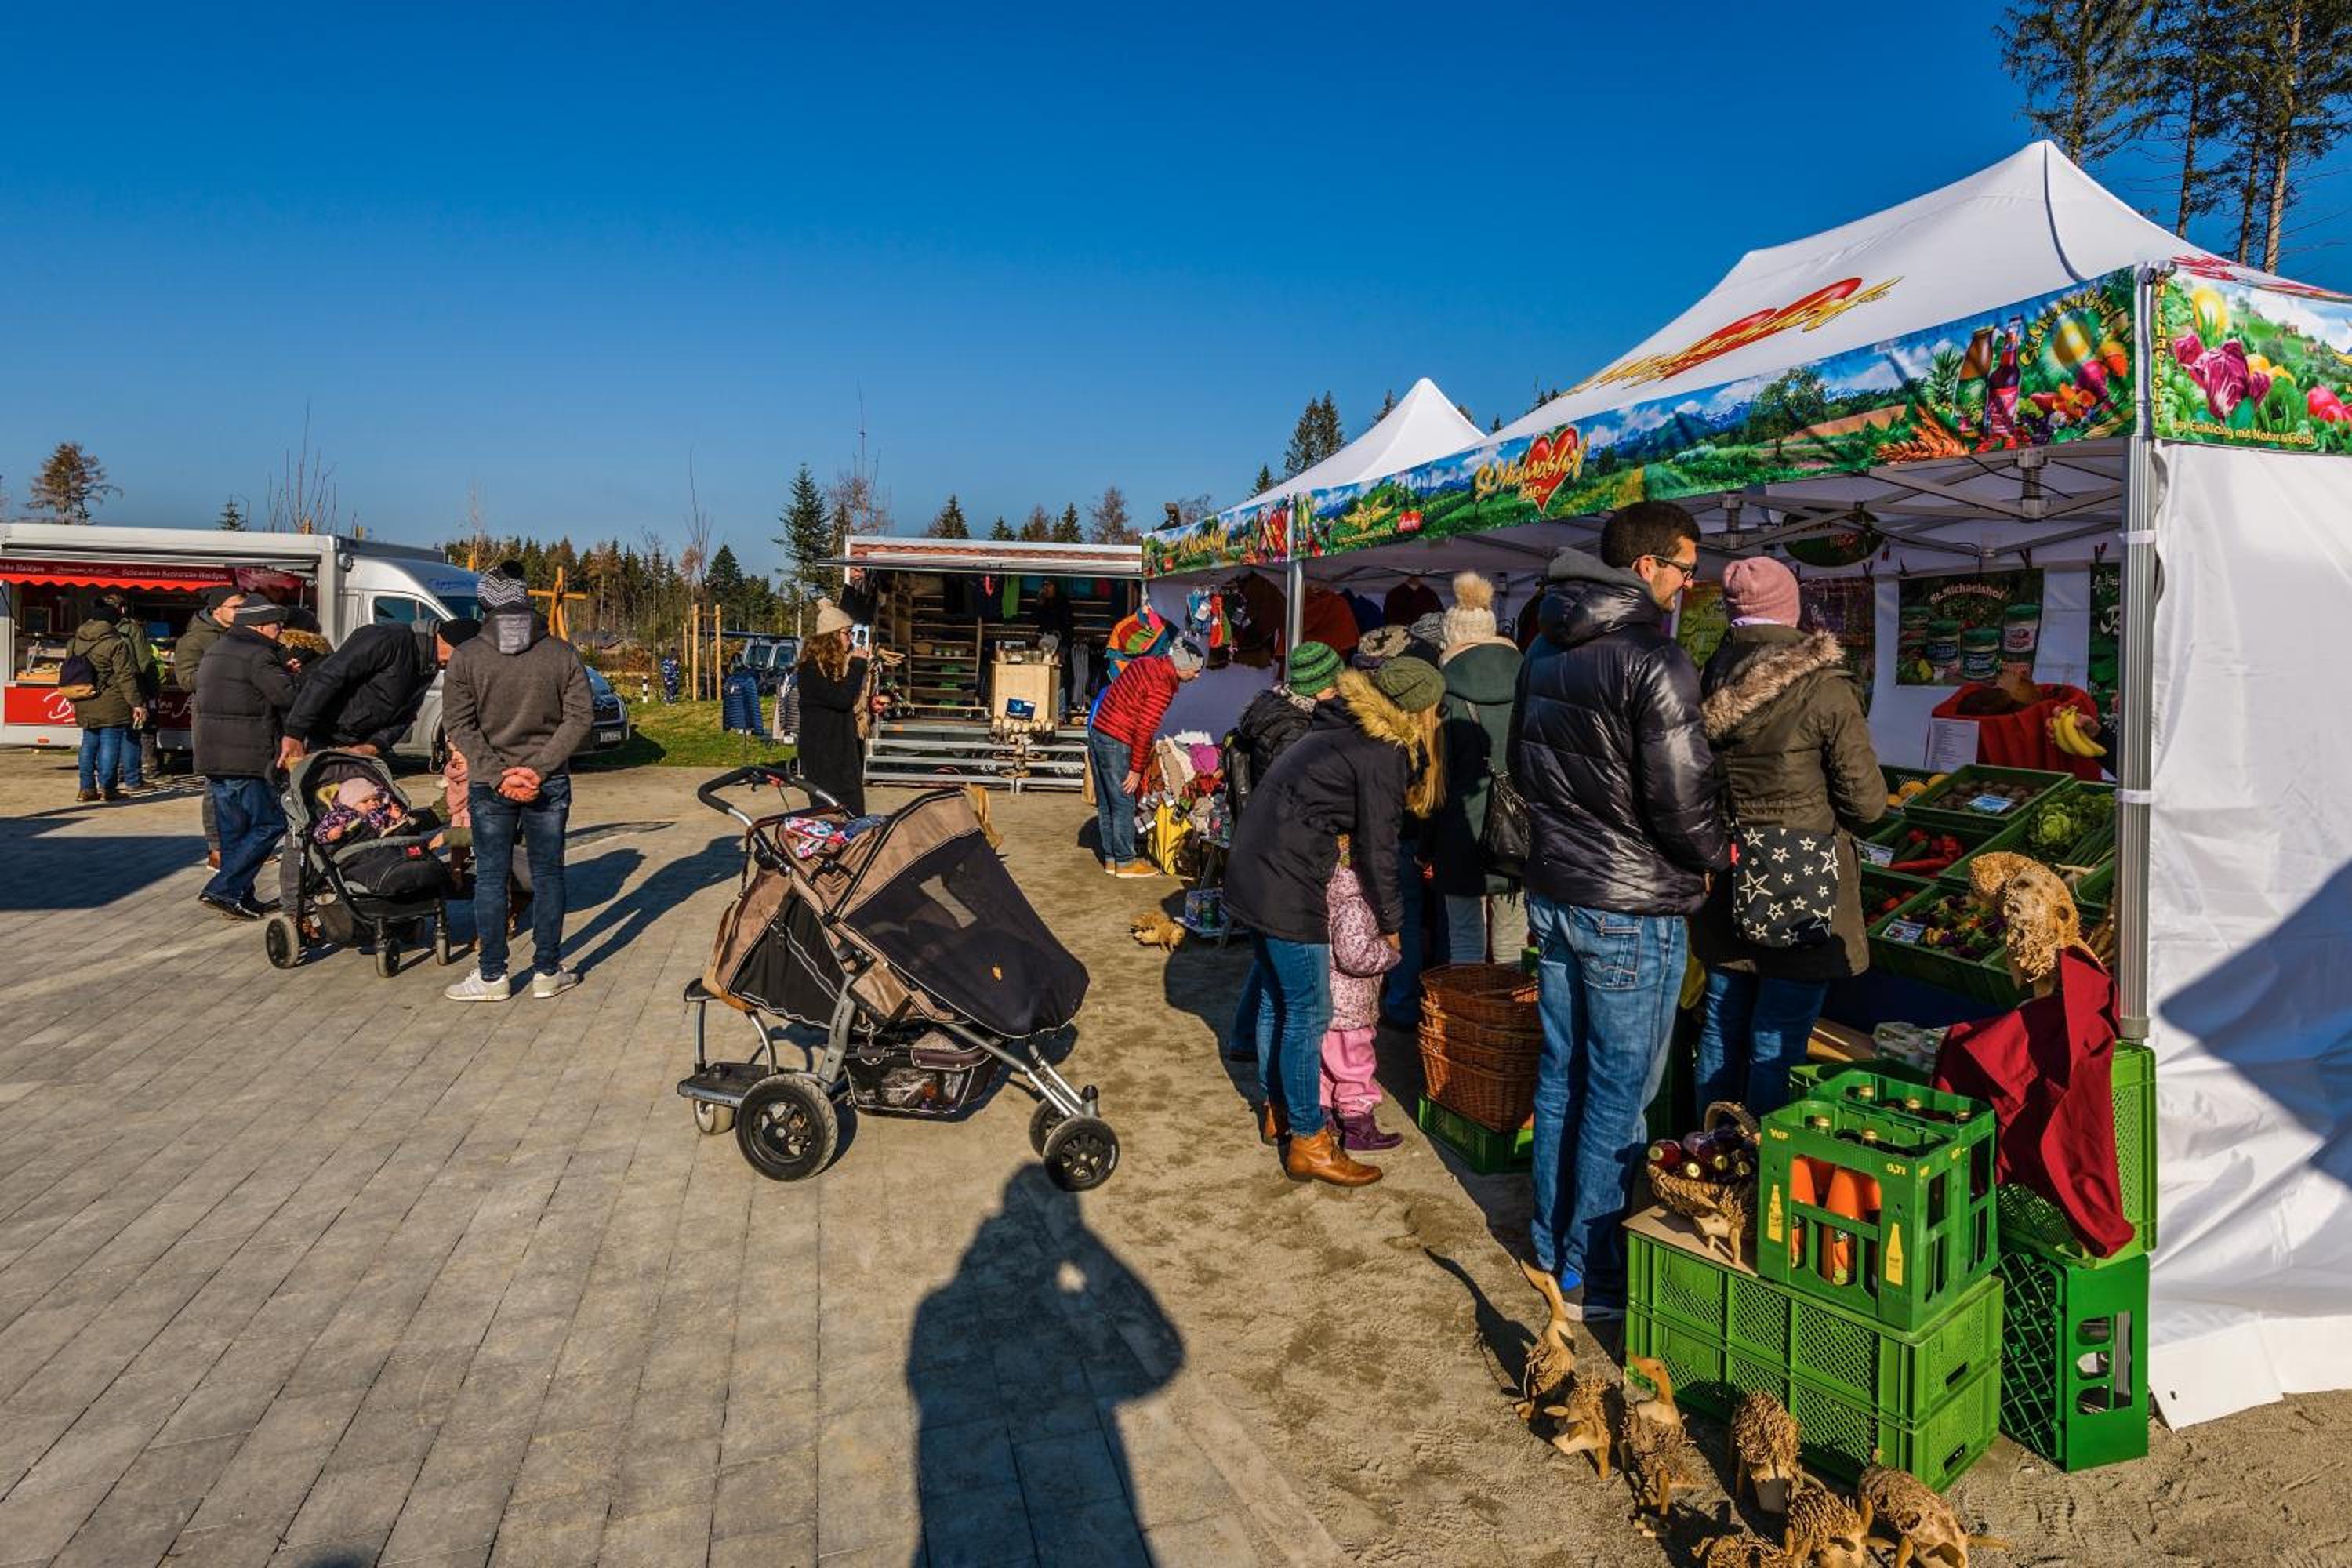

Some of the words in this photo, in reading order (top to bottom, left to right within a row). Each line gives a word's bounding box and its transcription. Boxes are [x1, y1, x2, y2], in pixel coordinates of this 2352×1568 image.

[2190, 419, 2234, 440] Einklang
[2251, 428, 2280, 442] Natur
[2288, 431, 2315, 445] Geist
